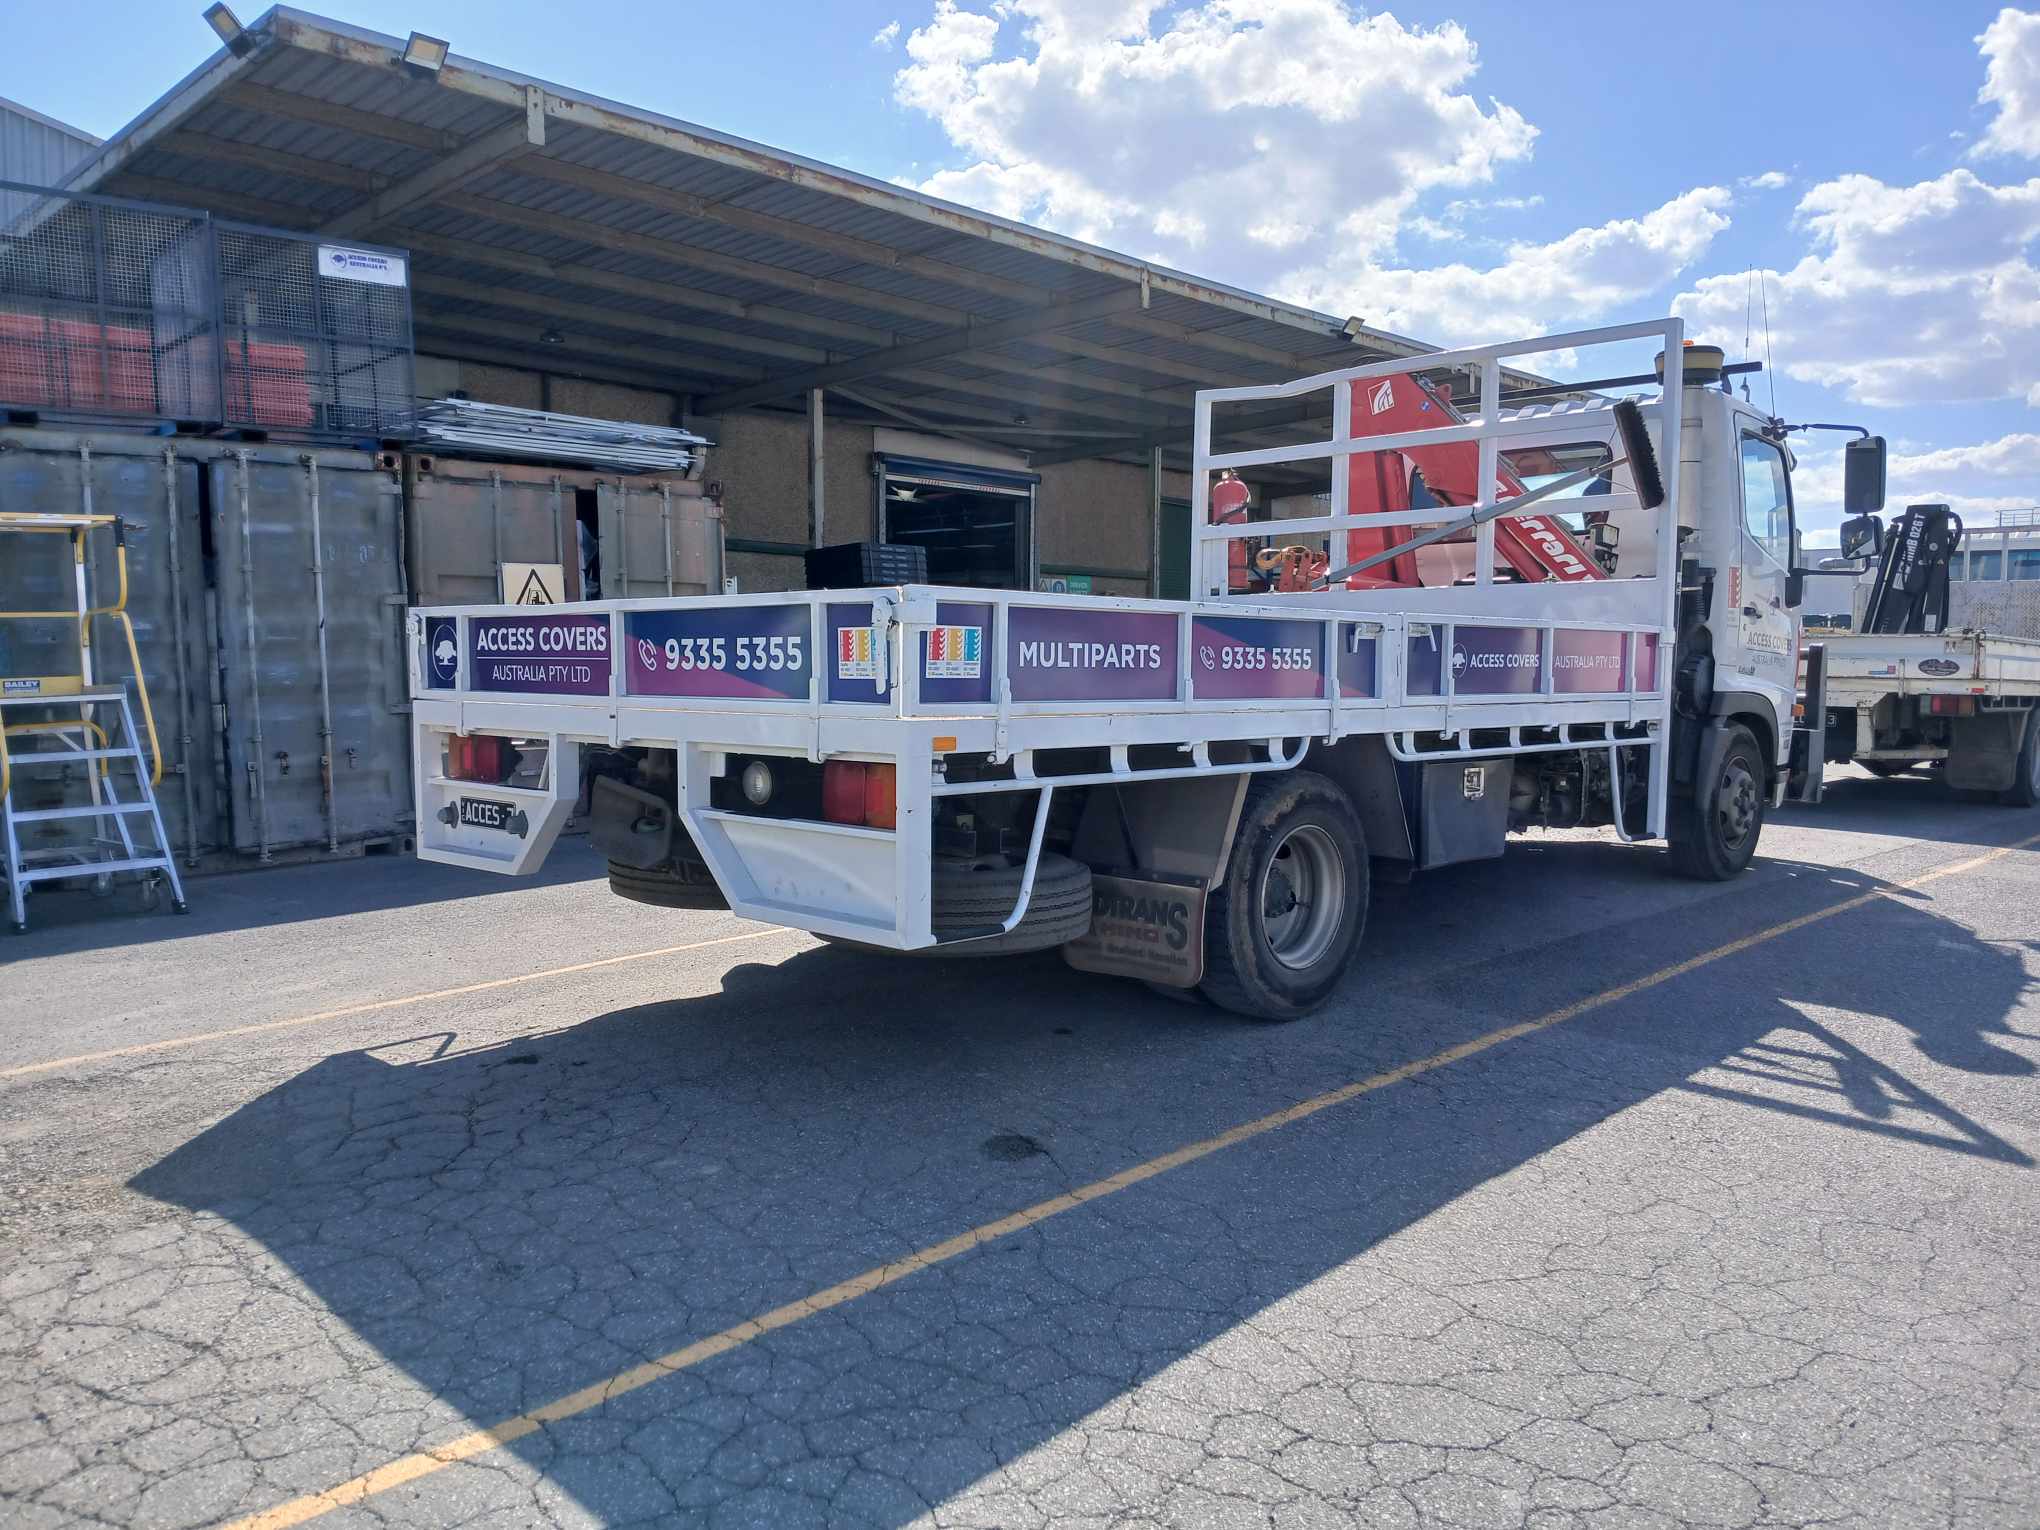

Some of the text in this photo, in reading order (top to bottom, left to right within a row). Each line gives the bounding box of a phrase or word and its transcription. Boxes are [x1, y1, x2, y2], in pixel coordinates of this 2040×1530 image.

[477, 626, 607, 651] ACCESS COVERS
[1747, 631, 1772, 648] ACCESS
[665, 638, 726, 671] 9335
[735, 636, 803, 671] 5355
[1019, 641, 1161, 668] MULTIPARTS
[1221, 646, 1312, 670] 9335 5355
[1470, 653, 1540, 668] ACCESS COVERS
[1554, 655, 1620, 669] AUSTRALIA PTY LTD
[492, 665, 591, 682] AUSTRALIA PTY LTD
